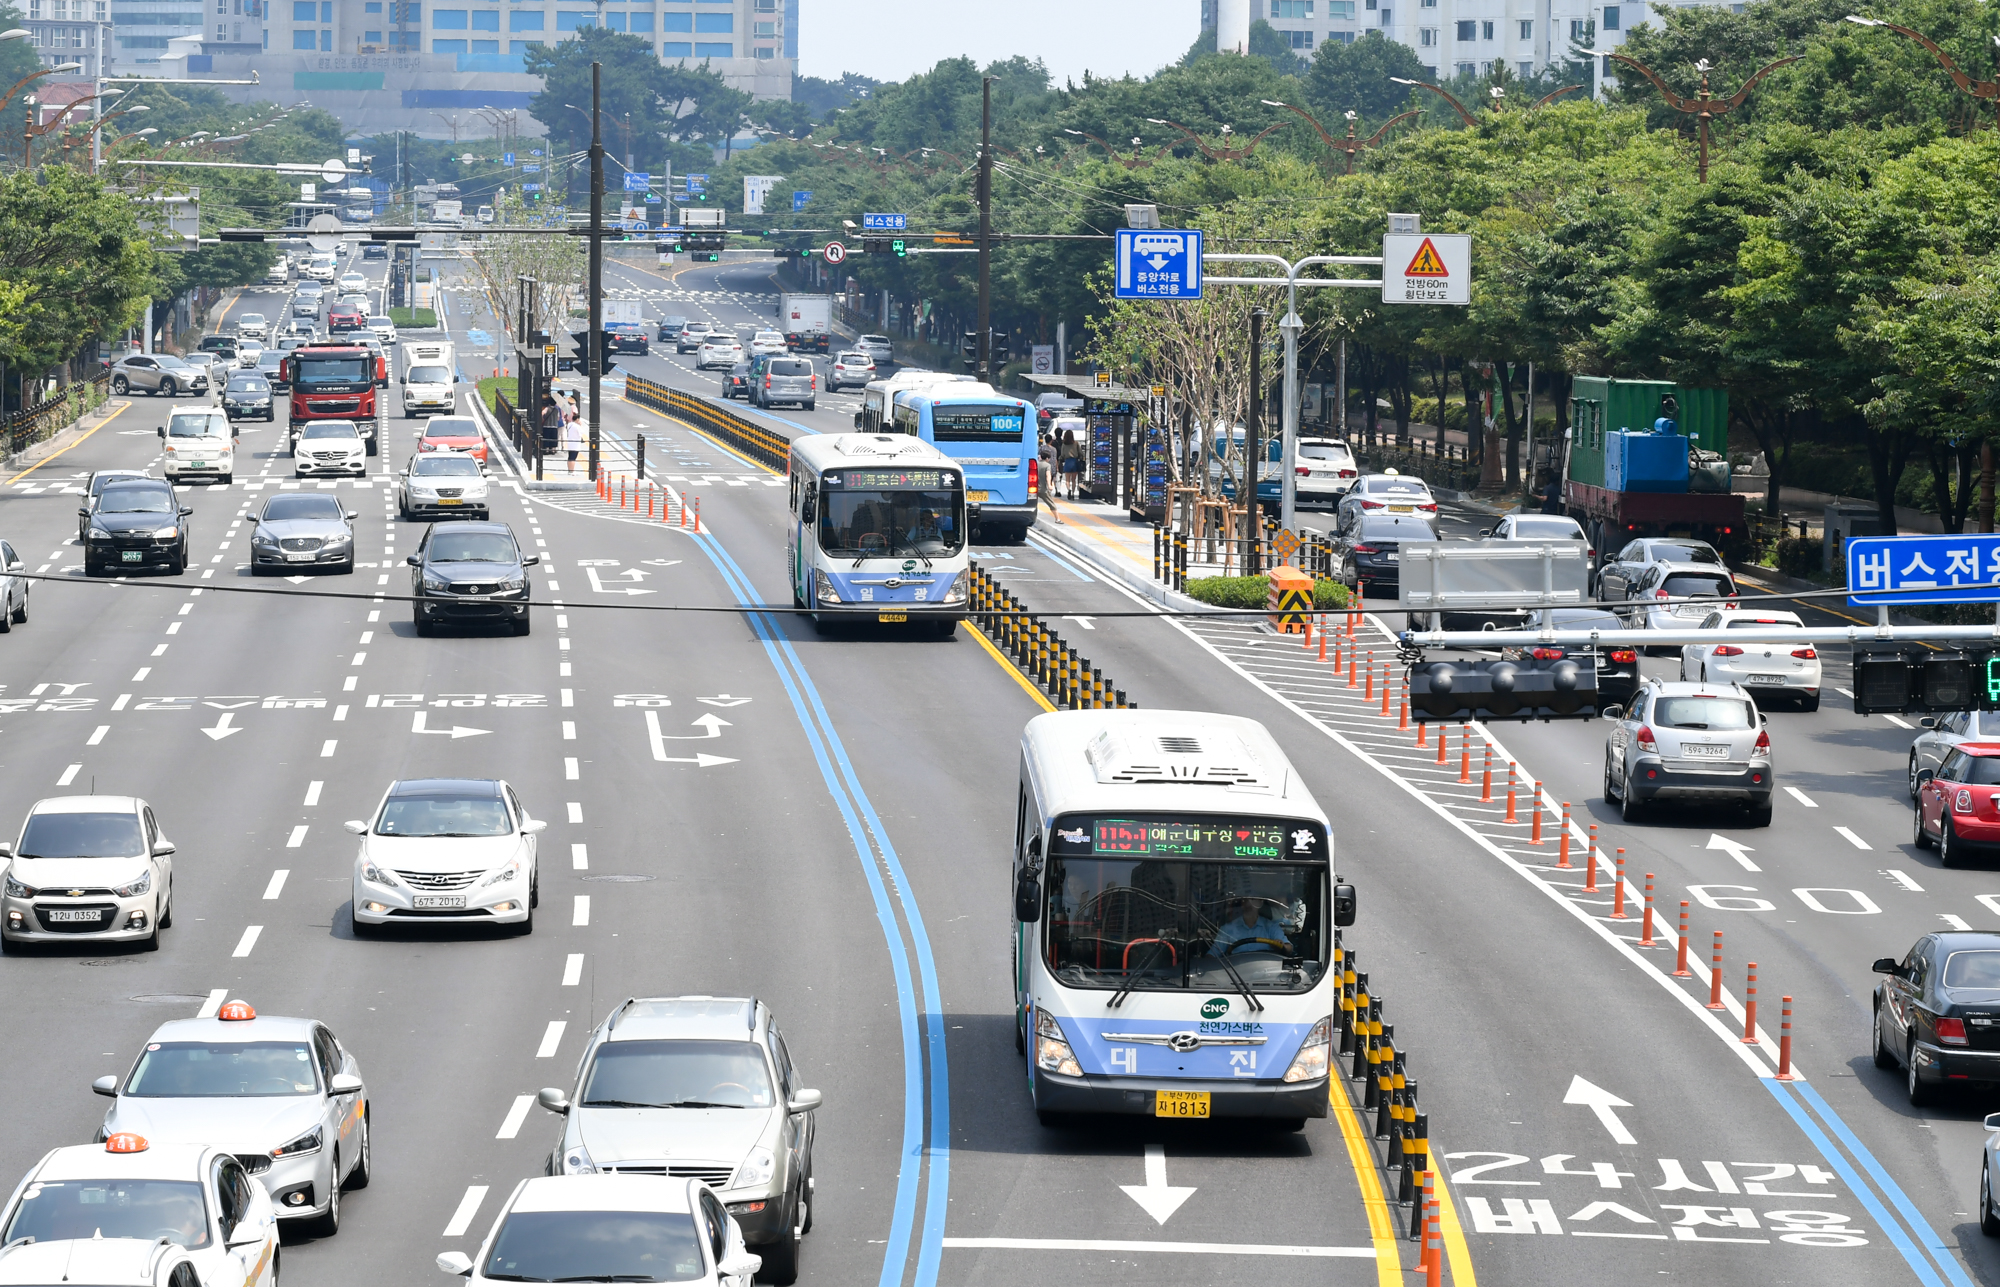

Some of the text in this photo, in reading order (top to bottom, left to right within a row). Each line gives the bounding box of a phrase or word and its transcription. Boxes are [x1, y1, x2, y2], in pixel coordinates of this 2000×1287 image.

[865, 215, 905, 228] 버스전용
[1136, 271, 1181, 283] 중앙차로
[1405, 278, 1449, 289] 전방60m
[1136, 284, 1180, 295] 버스전용
[1404, 290, 1448, 300] 횡단보도
[992, 418, 1022, 430] 100-1
[914, 587, 928, 601] 광
[1704, 747, 1724, 756] 3264
[438, 897, 461, 906] 2012
[74, 911, 97, 920] 0352
[1202, 1003, 1228, 1013] CNG
[1199, 1021, 1264, 1034] 천연가스버스
[1110, 1047, 1257, 1077] 대 진
[1169, 1091, 1198, 1100] 부산 70
[1444, 1151, 1837, 1198] 24시간
[1465, 1196, 1870, 1248] 버스전용
